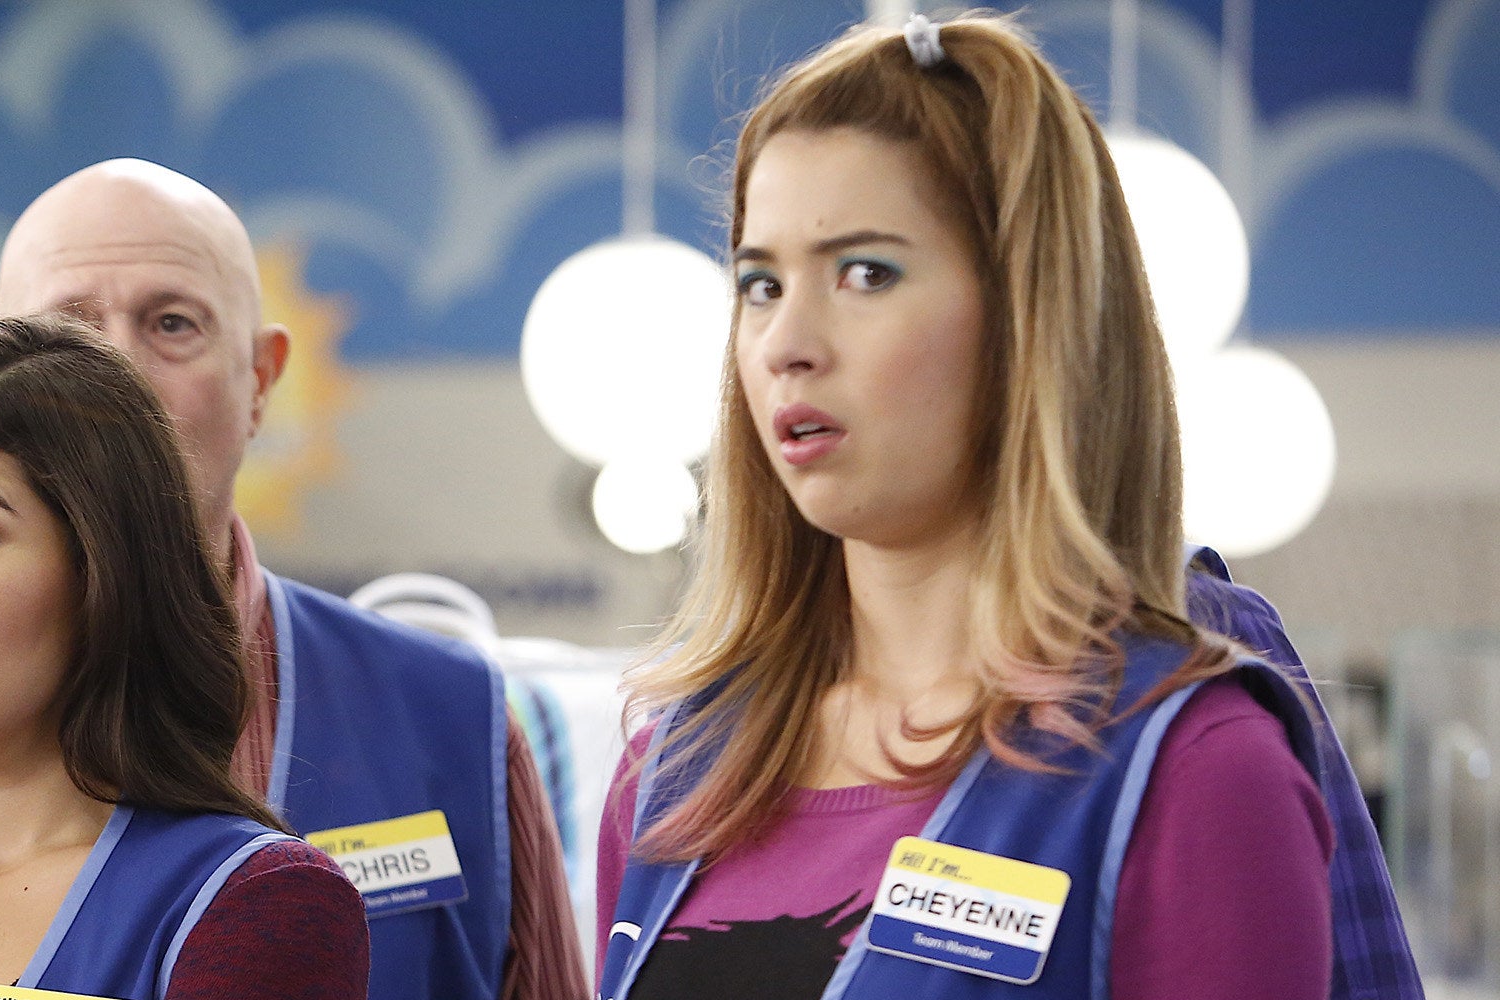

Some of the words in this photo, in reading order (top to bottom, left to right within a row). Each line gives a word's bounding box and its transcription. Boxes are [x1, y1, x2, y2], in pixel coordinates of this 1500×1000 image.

[341, 848, 431, 885] CHRIS
[889, 883, 1046, 938] CHEYENNE
[913, 932, 945, 950] Team
[945, 940, 994, 961] Member
